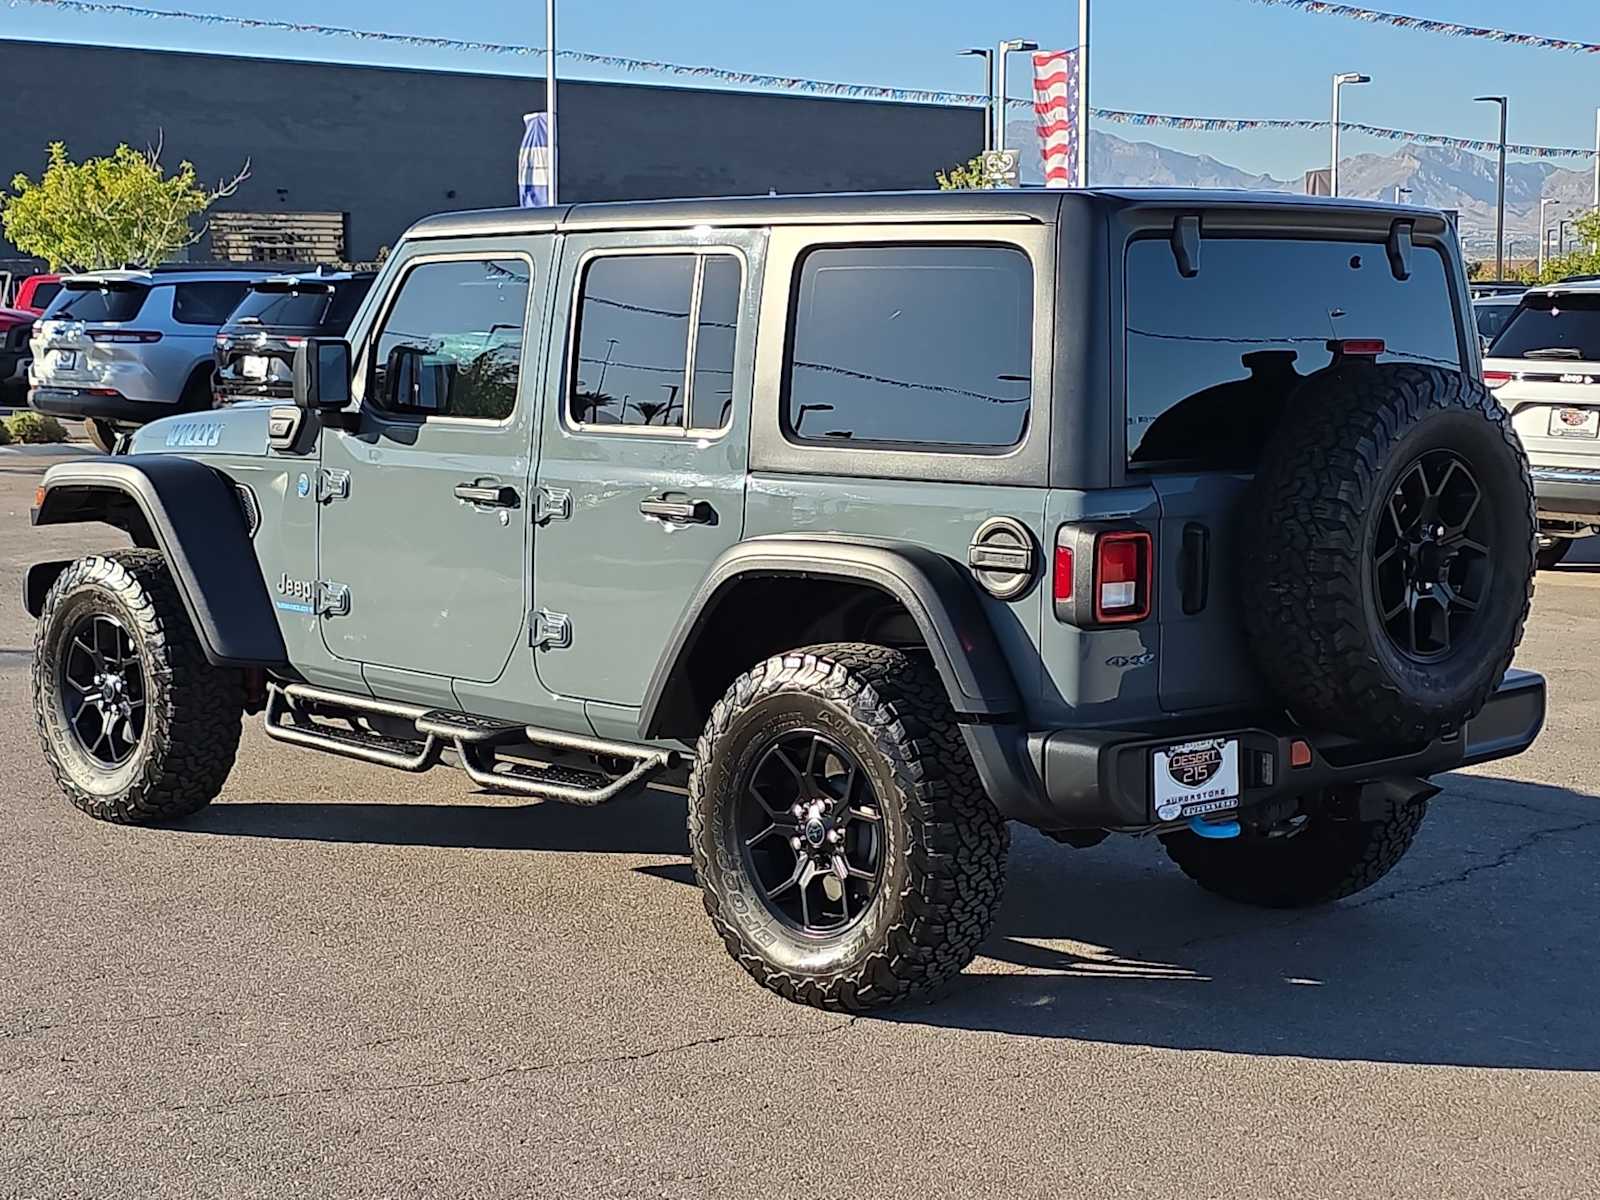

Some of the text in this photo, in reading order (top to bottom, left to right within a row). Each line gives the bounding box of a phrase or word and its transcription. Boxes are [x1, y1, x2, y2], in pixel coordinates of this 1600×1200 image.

[1560, 373, 1583, 383] Jeep
[276, 572, 312, 603] Jeep
[1172, 749, 1219, 767] DESERT
[1183, 765, 1208, 782] 215
[1166, 788, 1226, 804] SUPERSTORE
